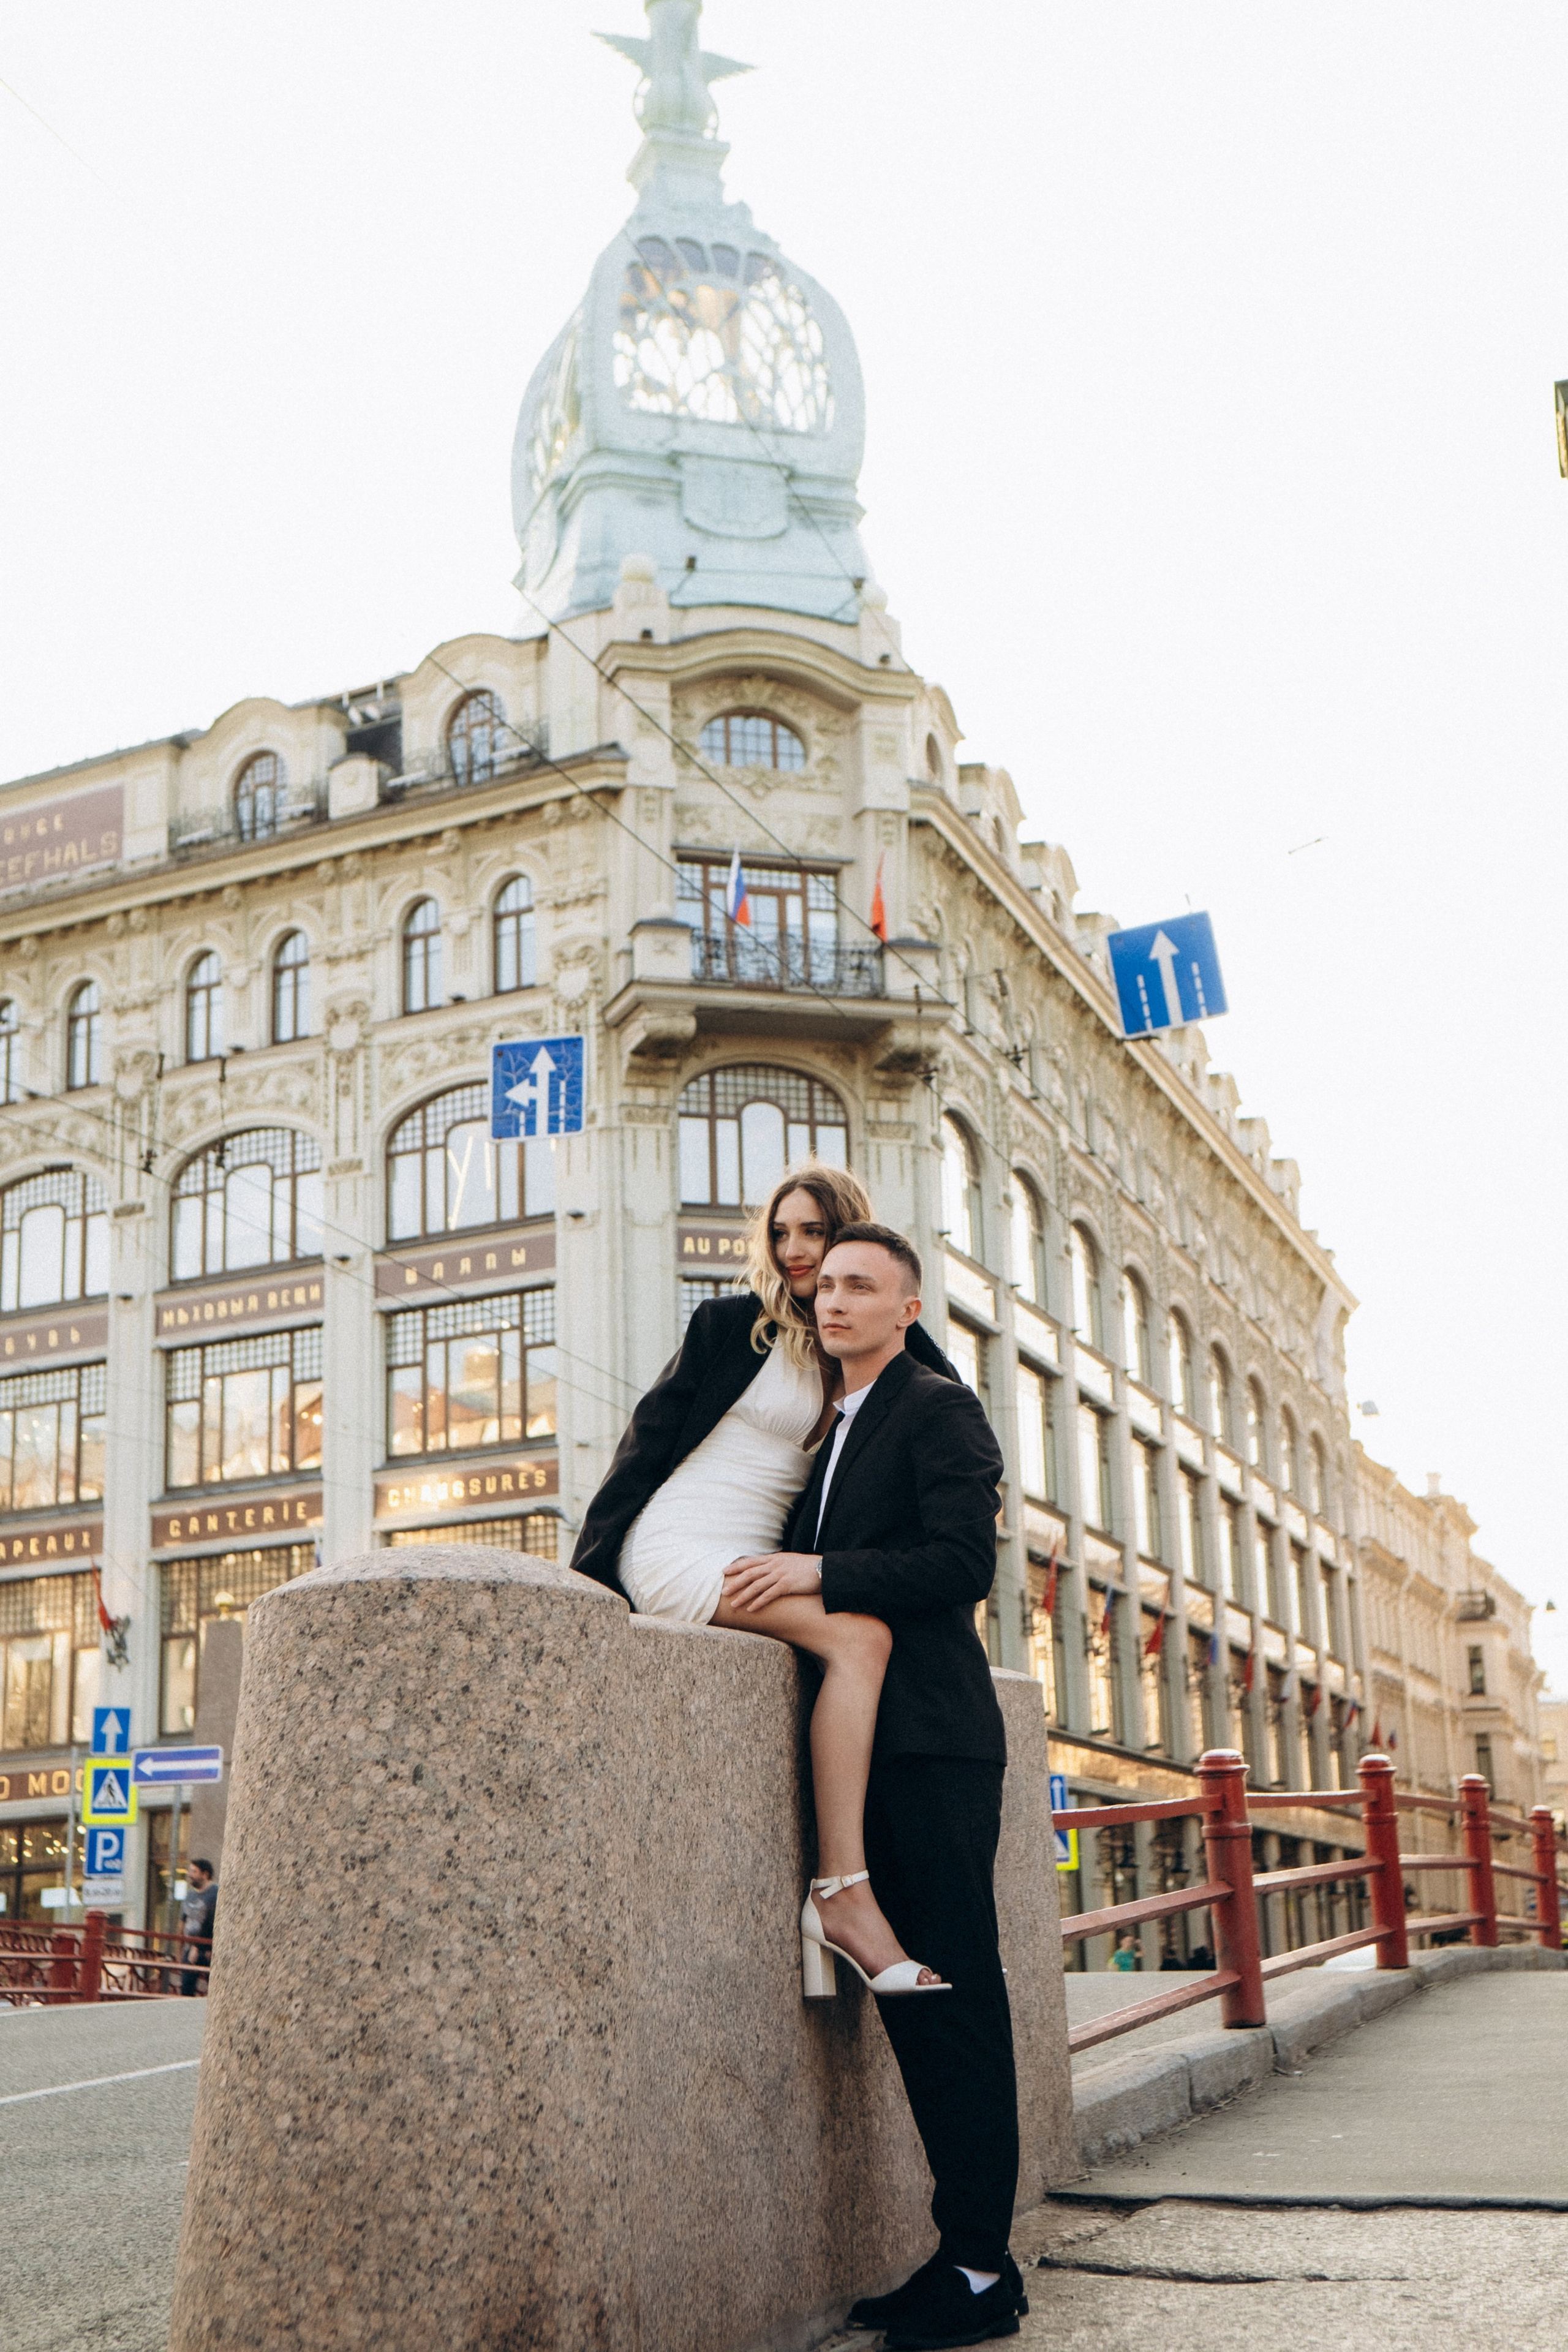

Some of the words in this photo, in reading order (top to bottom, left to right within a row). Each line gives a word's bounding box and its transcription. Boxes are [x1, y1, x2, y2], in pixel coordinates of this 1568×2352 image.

[684, 1236, 710, 1254] AU
[388, 1469, 546, 1507] CHAUSSURES
[95, 1831, 119, 1871] P
